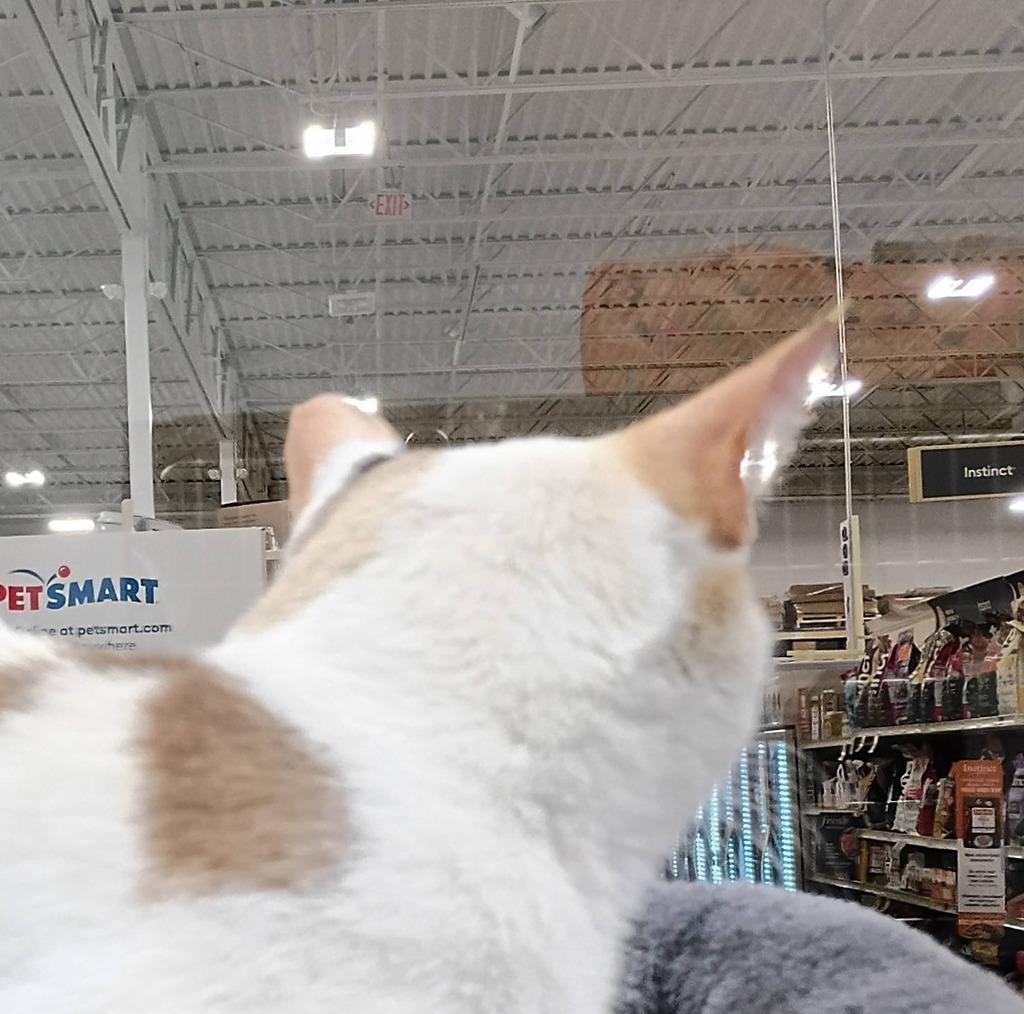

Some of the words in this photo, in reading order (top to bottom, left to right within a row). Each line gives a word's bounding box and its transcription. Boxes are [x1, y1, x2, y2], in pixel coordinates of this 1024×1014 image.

[375, 193, 406, 216] EXIT
[964, 465, 1014, 478] Instinct
[60, 625, 74, 636] at
[78, 624, 172, 638] petsmart.com
